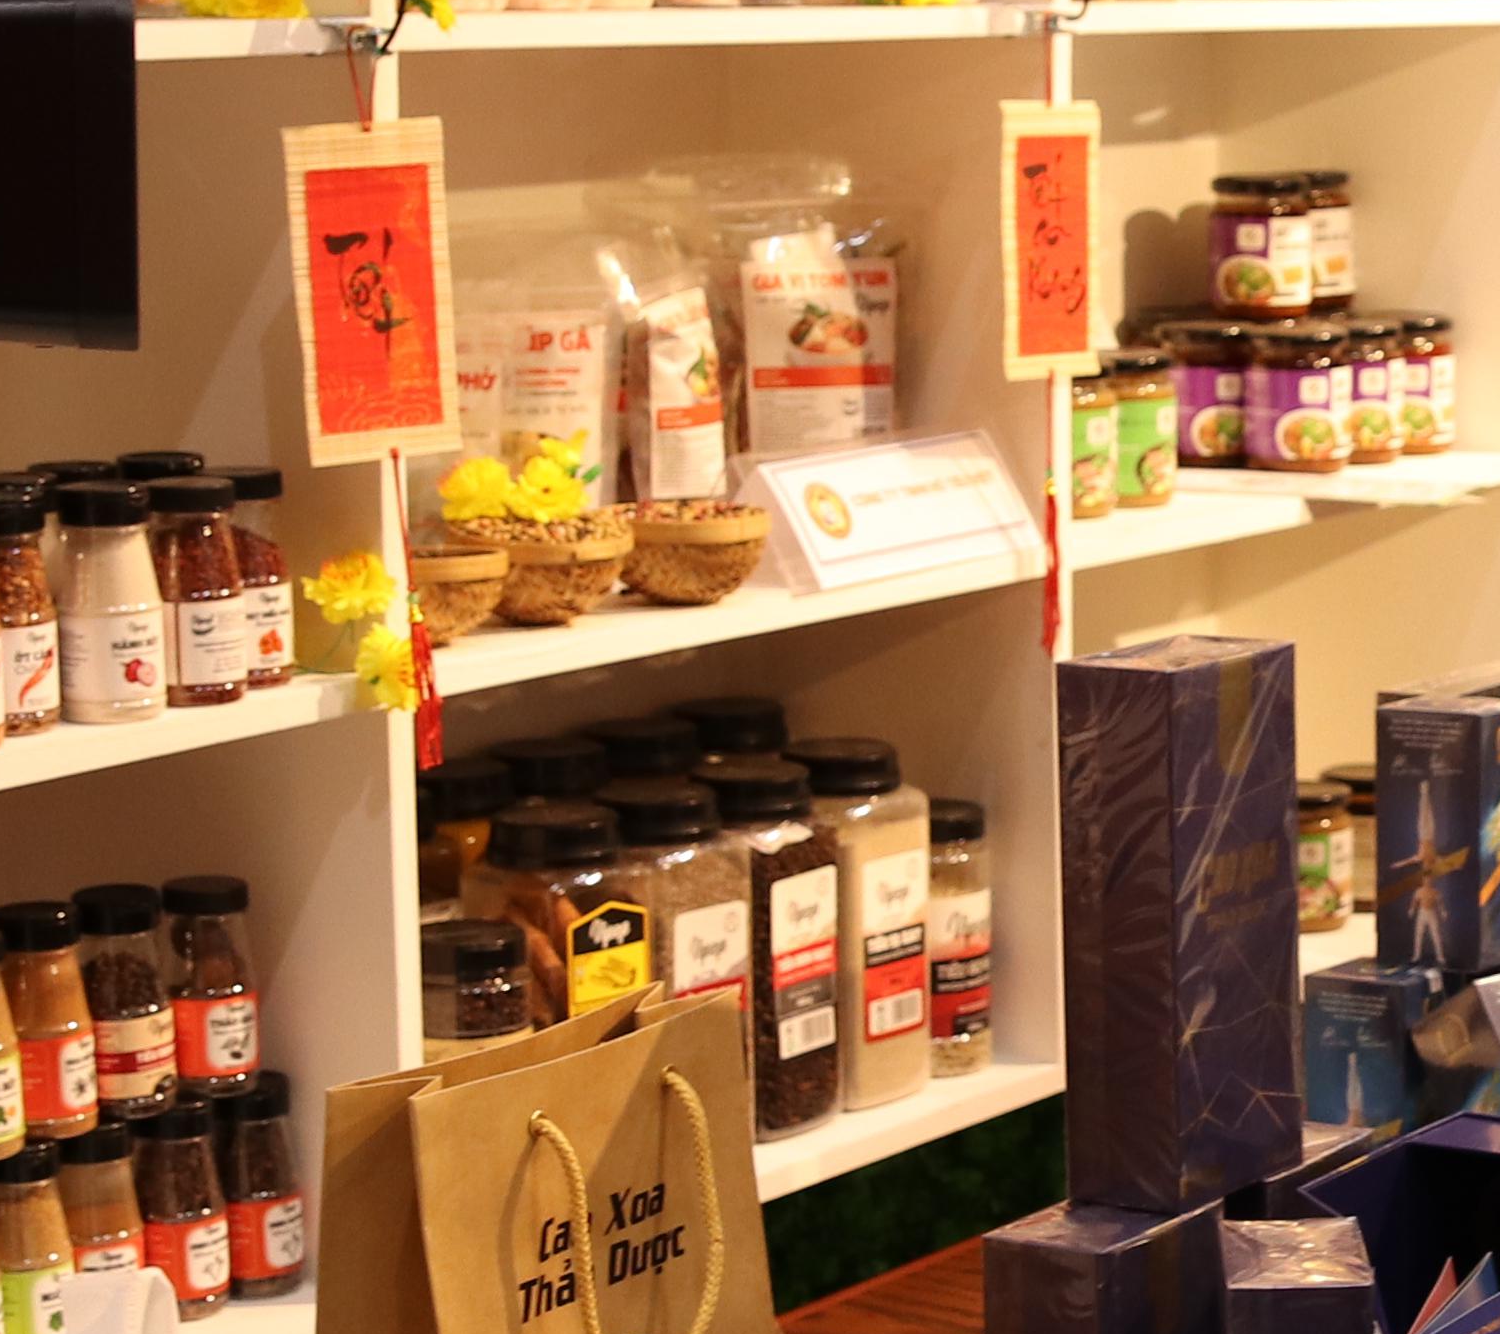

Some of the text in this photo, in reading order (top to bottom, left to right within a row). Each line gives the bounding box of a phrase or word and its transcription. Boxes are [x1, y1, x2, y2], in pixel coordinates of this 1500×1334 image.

[539, 1183, 665, 1263] Ca Xoa
[518, 1259, 595, 1324] Thả
